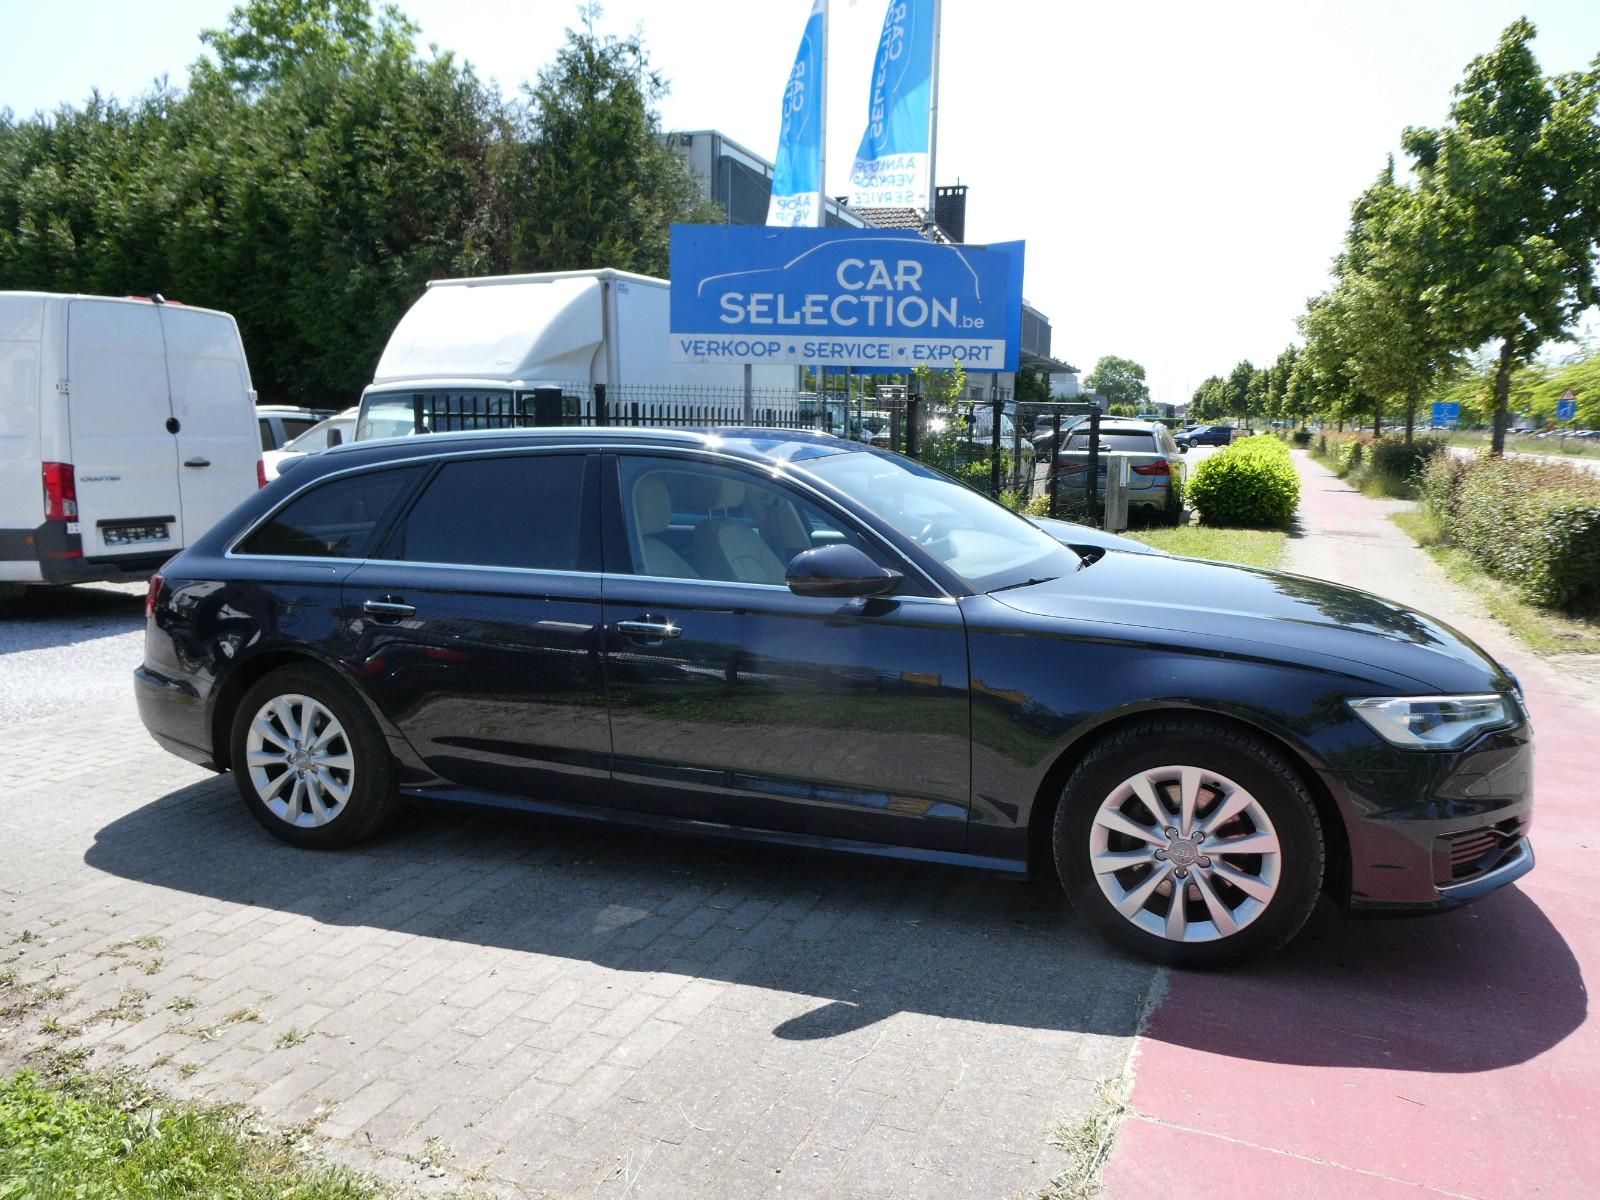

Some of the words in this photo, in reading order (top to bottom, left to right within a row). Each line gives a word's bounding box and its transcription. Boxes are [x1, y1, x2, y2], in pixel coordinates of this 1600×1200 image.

[836, 258, 923, 292] CAR
[681, 340, 782, 357] VERKOOP
[803, 342, 890, 360] SERVICE
[913, 345, 993, 361] EXPORT
